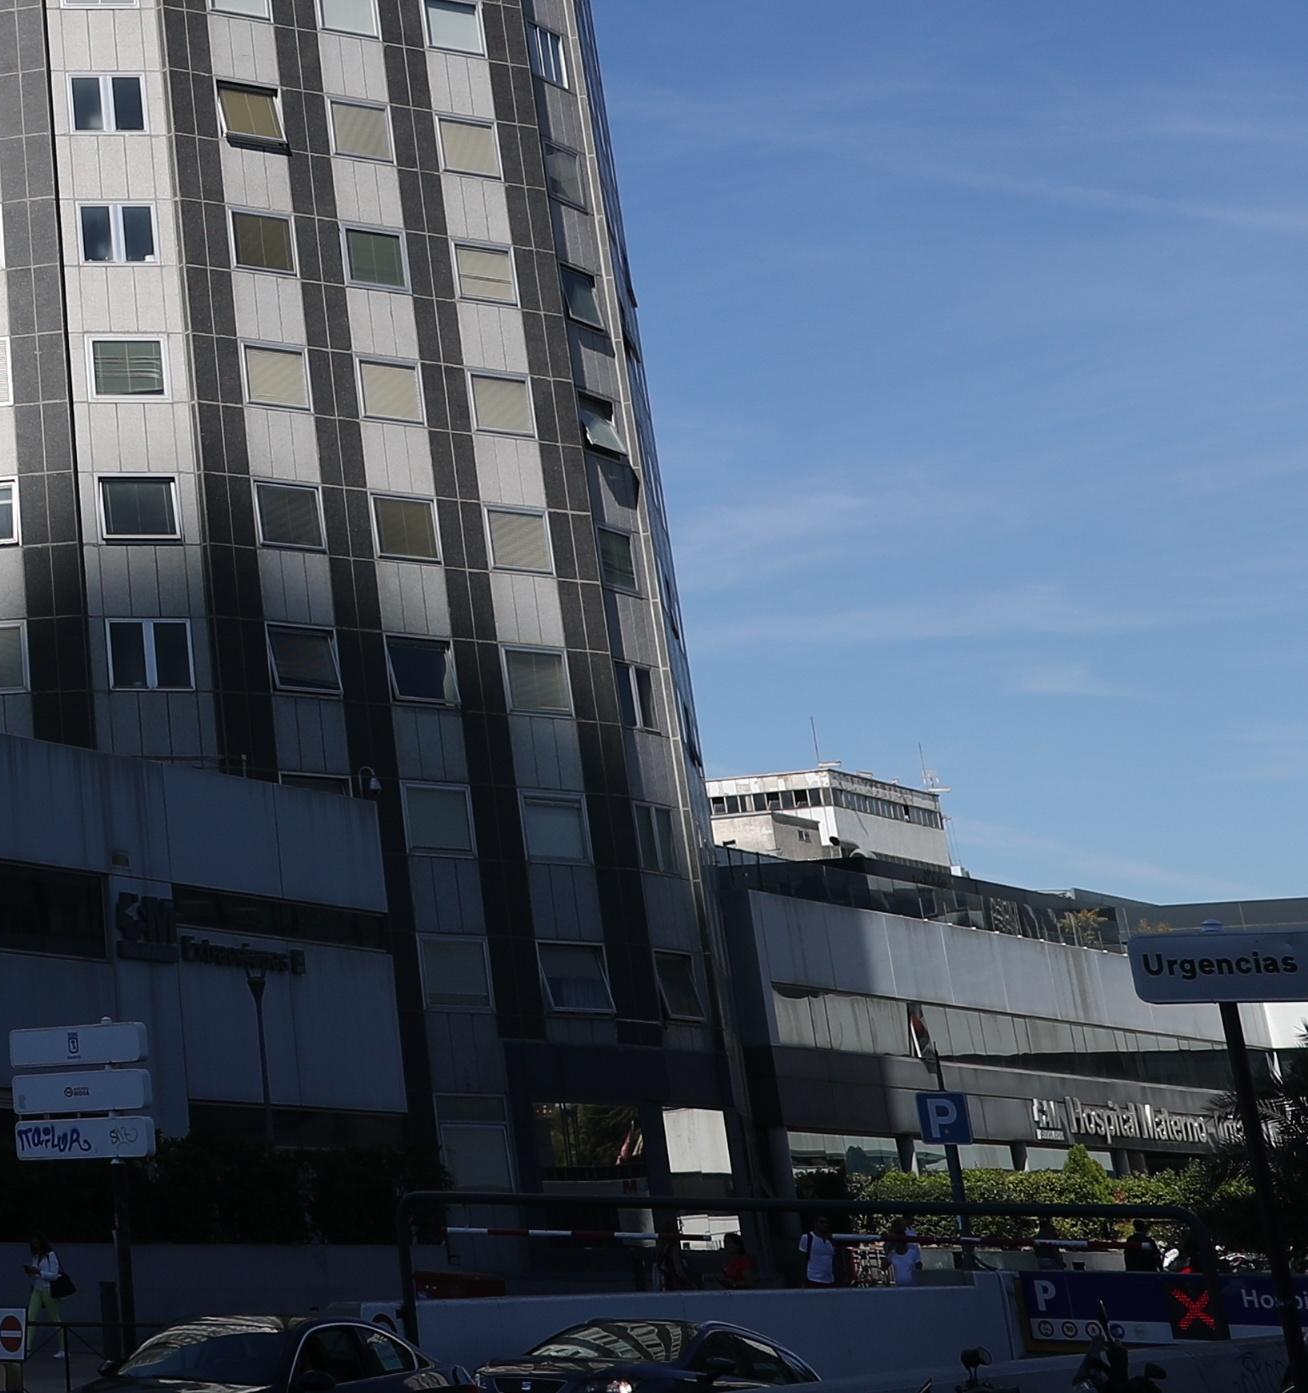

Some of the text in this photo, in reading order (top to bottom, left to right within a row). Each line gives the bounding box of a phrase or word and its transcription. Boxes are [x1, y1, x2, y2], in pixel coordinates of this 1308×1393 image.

[1142, 951, 1299, 980] Urgencias
[926, 1098, 957, 1138] P
[1064, 1095, 1140, 1144] Hospital
[1033, 1279, 1057, 1312] P
